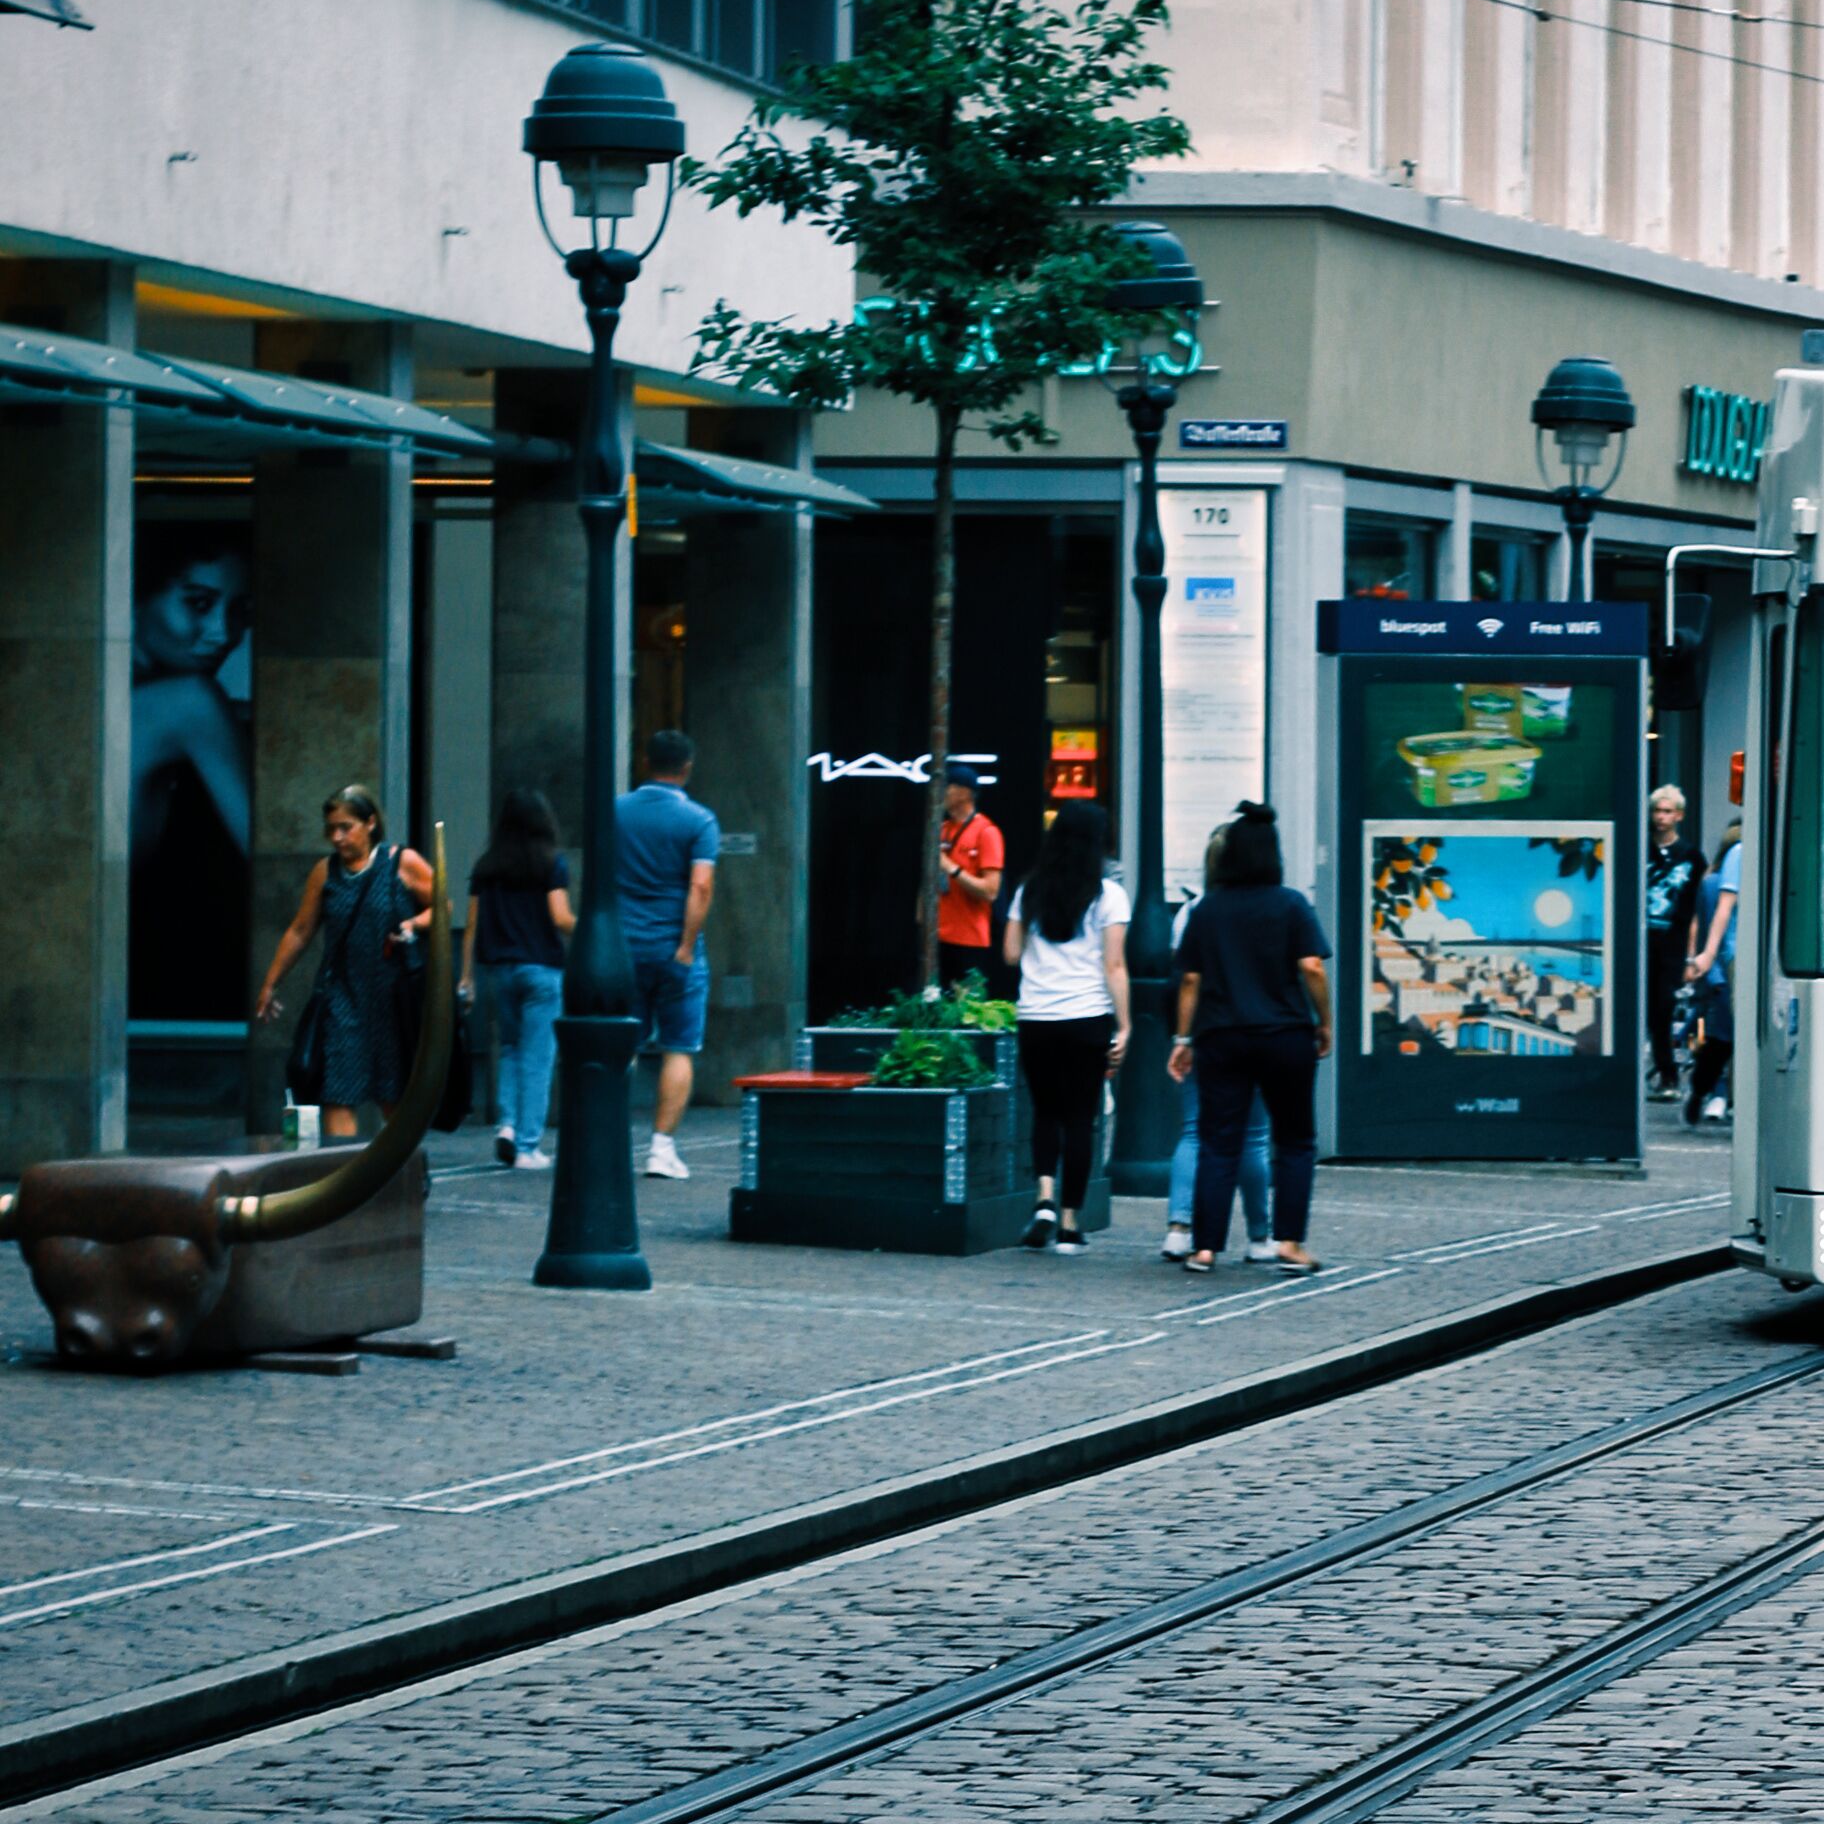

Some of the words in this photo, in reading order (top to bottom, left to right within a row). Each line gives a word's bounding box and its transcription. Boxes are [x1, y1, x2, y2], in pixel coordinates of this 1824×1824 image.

[1192, 507, 1231, 524] 170
[1379, 619, 1447, 636] bluespot
[1529, 621, 1563, 635] Free
